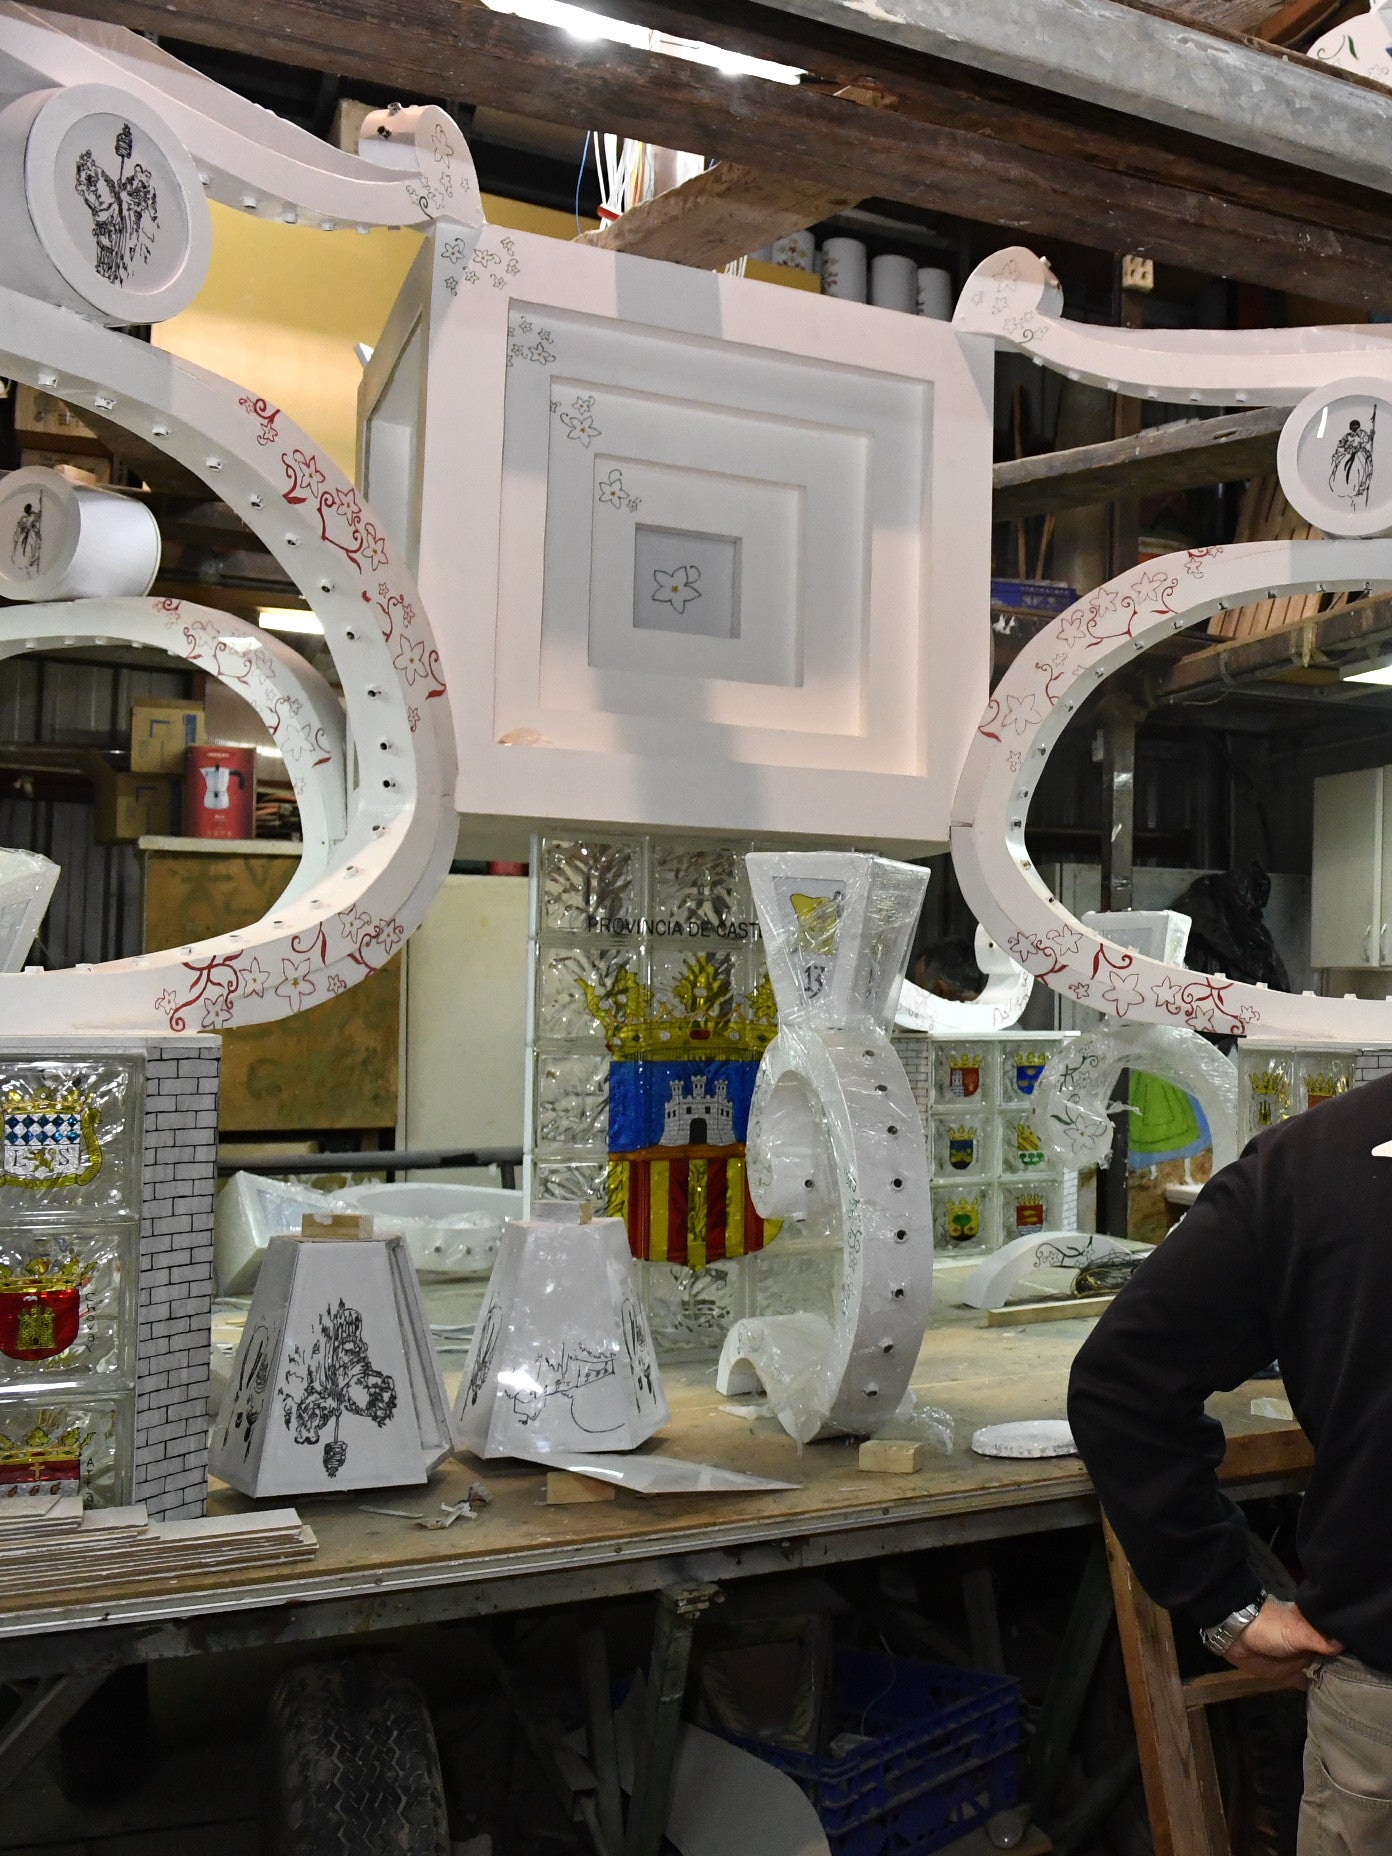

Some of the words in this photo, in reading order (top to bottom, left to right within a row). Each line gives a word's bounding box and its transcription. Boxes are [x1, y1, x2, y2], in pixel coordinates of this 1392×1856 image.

[587, 915, 683, 937] PROVINCIA
[689, 921, 709, 939] DE
[716, 921, 763, 939] CAST
[58, 1146, 70, 1167] S
